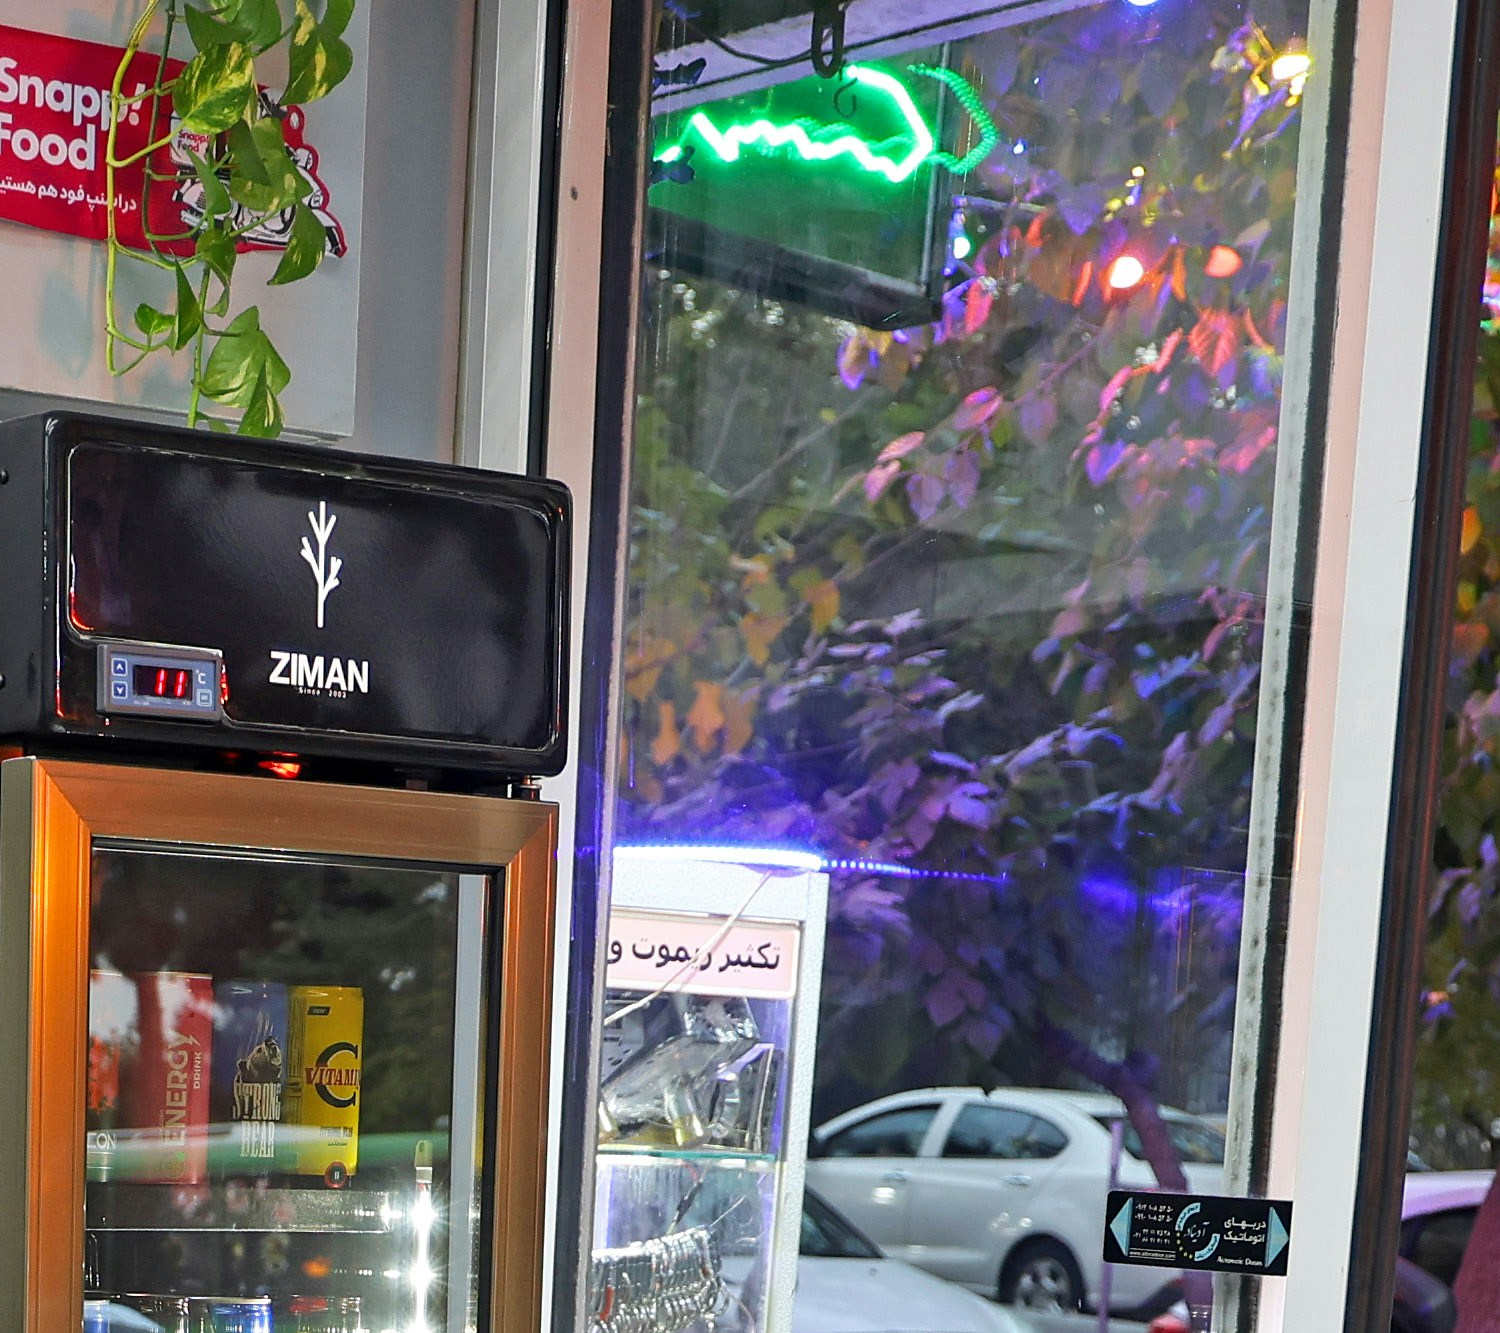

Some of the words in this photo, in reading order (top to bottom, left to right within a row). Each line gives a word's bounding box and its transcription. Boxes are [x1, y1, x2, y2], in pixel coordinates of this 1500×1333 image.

[37, 184, 59, 199] هم
[60, 184, 85, 205] فود
[154, 667, 189, 698] 11
[269, 650, 370, 693] ZIMAN
[298, 687, 321, 697] Since
[606, 939, 623, 965] و
[632, 937, 712, 972] ریموت
[718, 941, 781, 973] تکثیر
[193, 1051, 202, 1090] DRINK
[165, 1028, 196, 1146] ENERGY
[232, 1080, 282, 1120] STRONG
[239, 1120, 276, 1158] BEAR
[1223, 1230, 1266, 1245] اتوماتیک
